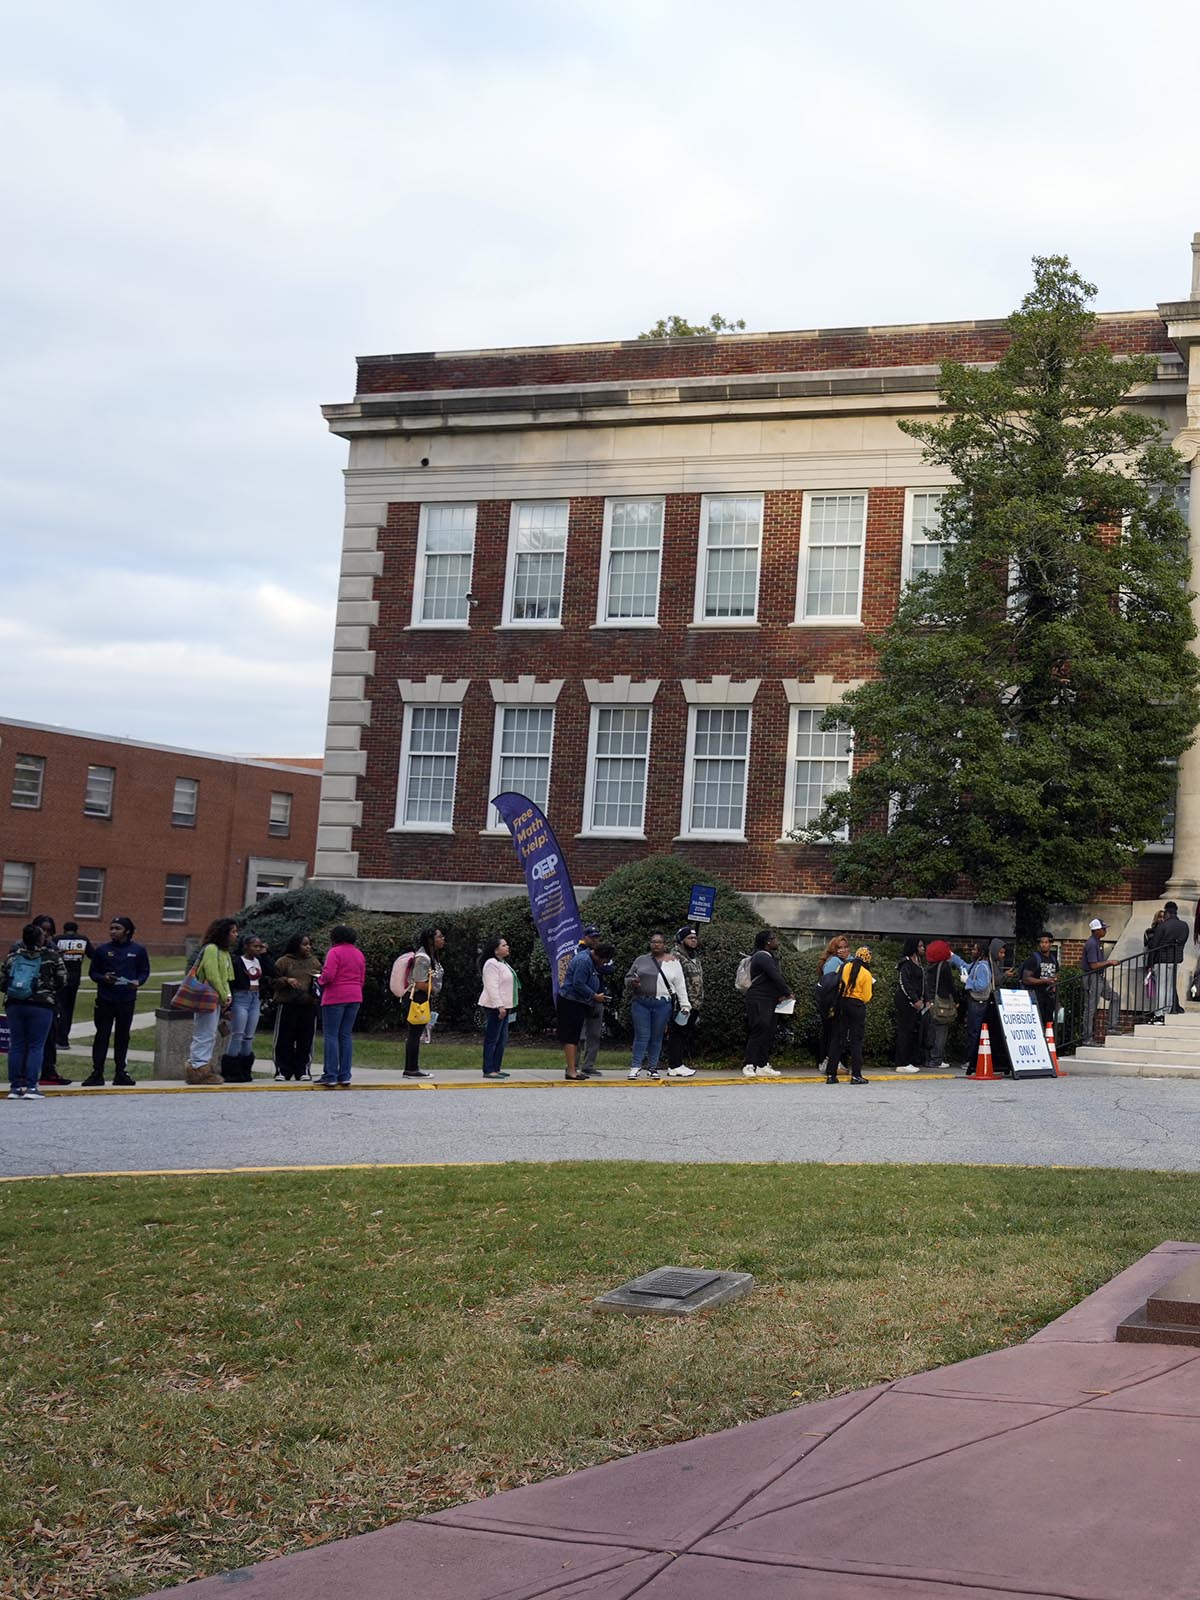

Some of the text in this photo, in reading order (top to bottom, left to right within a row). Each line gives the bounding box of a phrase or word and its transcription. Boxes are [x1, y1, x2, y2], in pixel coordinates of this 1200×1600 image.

[512, 808, 534, 829] Free
[516, 818, 544, 844] Math
[521, 830, 549, 858] Help!
[531, 853, 559, 881] QEP
[1003, 1013, 1037, 1024] CURBSIDE
[1010, 1029, 1037, 1041] VOTING
[1018, 1045, 1037, 1056] ONLY
